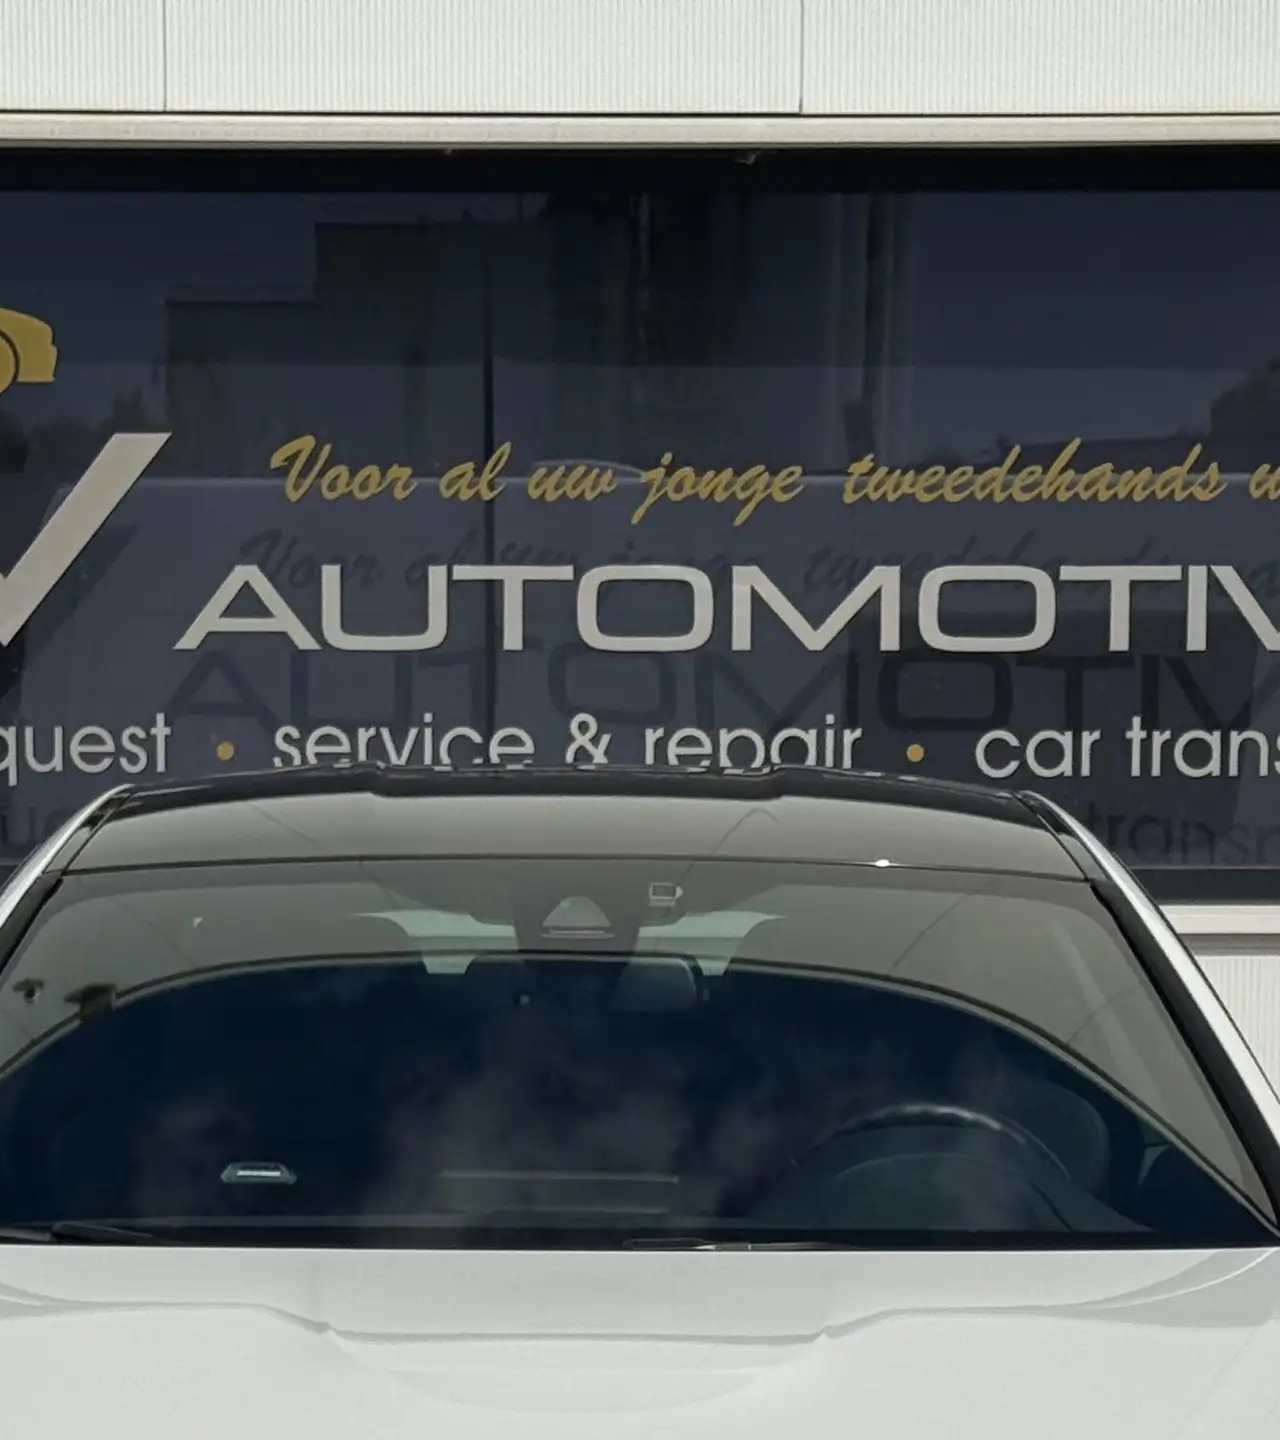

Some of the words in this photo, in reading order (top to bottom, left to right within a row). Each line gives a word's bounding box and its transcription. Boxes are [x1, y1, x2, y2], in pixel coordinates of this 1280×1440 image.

[270, 434, 417, 502] Voor
[439, 442, 513, 502] al
[526, 465, 618, 501] uw
[630, 451, 803, 526] jonge
[842, 438, 1228, 504] tweedehands
[273, 712, 536, 767] service
[565, 712, 612, 766] &
[645, 712, 863, 770] repair
[975, 729, 1101, 778] car
